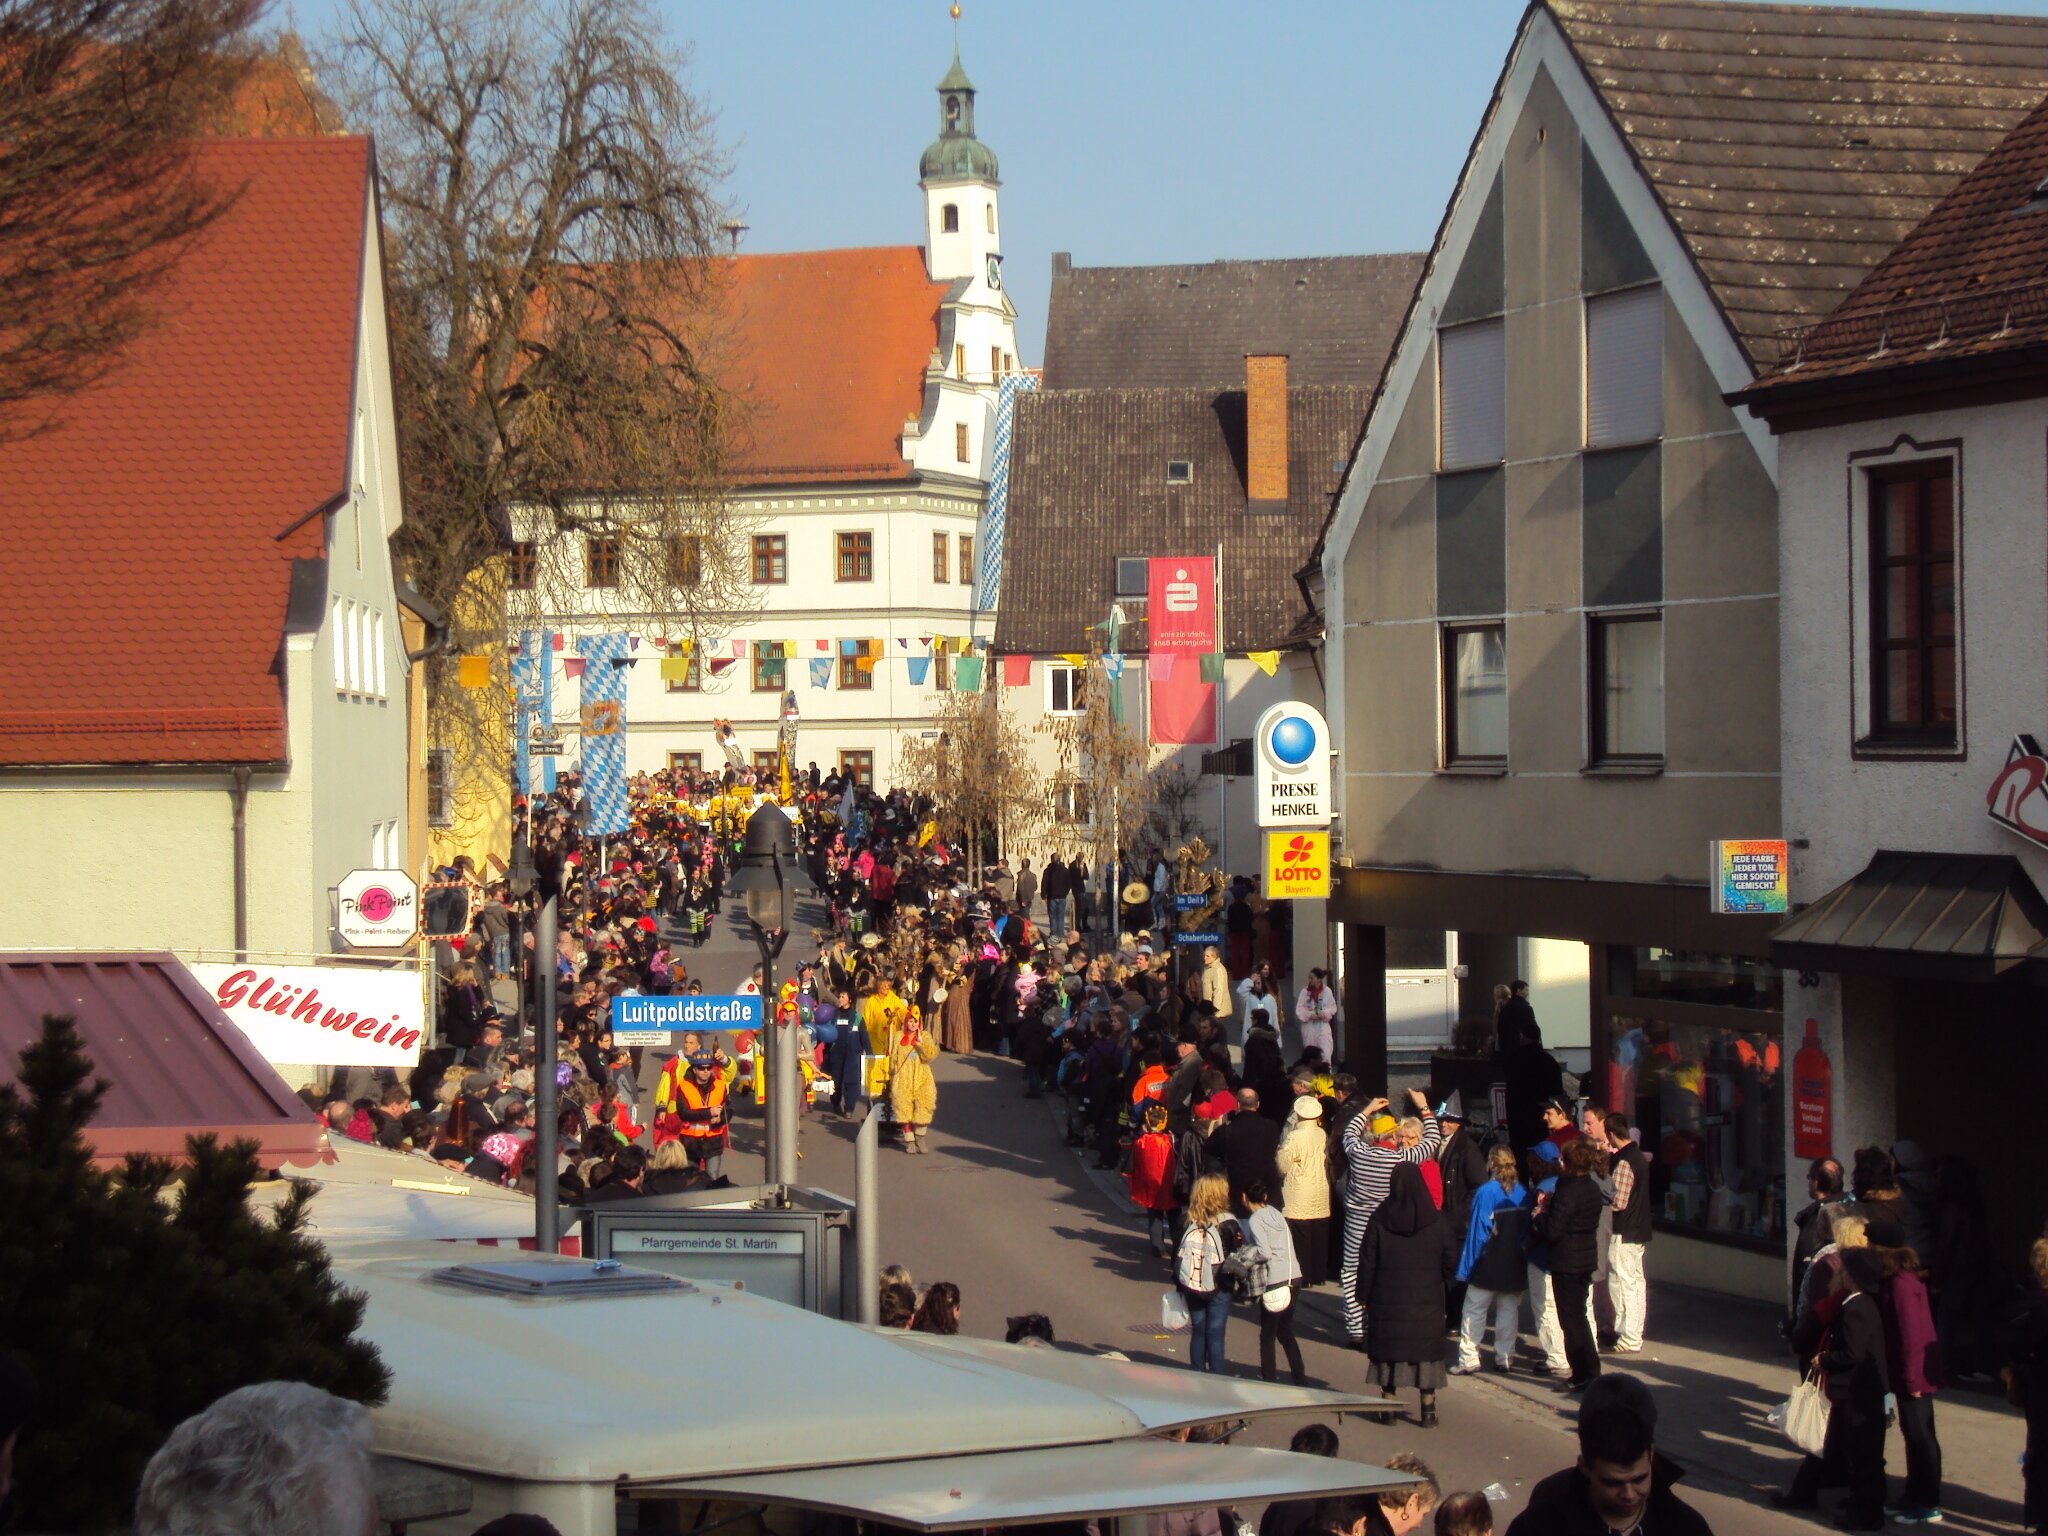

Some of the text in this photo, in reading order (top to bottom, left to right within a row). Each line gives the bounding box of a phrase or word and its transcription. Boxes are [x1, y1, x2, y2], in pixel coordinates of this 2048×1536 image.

[1271, 783, 1319, 797] PRESSE
[1272, 803, 1319, 816] HENKEL
[1733, 855, 1777, 863] JEDE FARBE.
[1275, 867, 1321, 881] LOTTO
[1734, 864, 1757, 872] JEDER
[1731, 873, 1748, 881] HIER
[1285, 885, 1312, 895] Bayern
[341, 891, 412, 915] Pink Point
[1178, 933, 1219, 942] Schaberlache
[217, 969, 421, 1050] Glühwein
[621, 1000, 752, 1028] Luitpoldstraße
[1799, 1101, 1825, 1114] Beratung
[1802, 1112, 1822, 1123] Verkauf
[1802, 1124, 1822, 1135] Service
[641, 1237, 778, 1251] Pfarrgemeinde St. Martin
